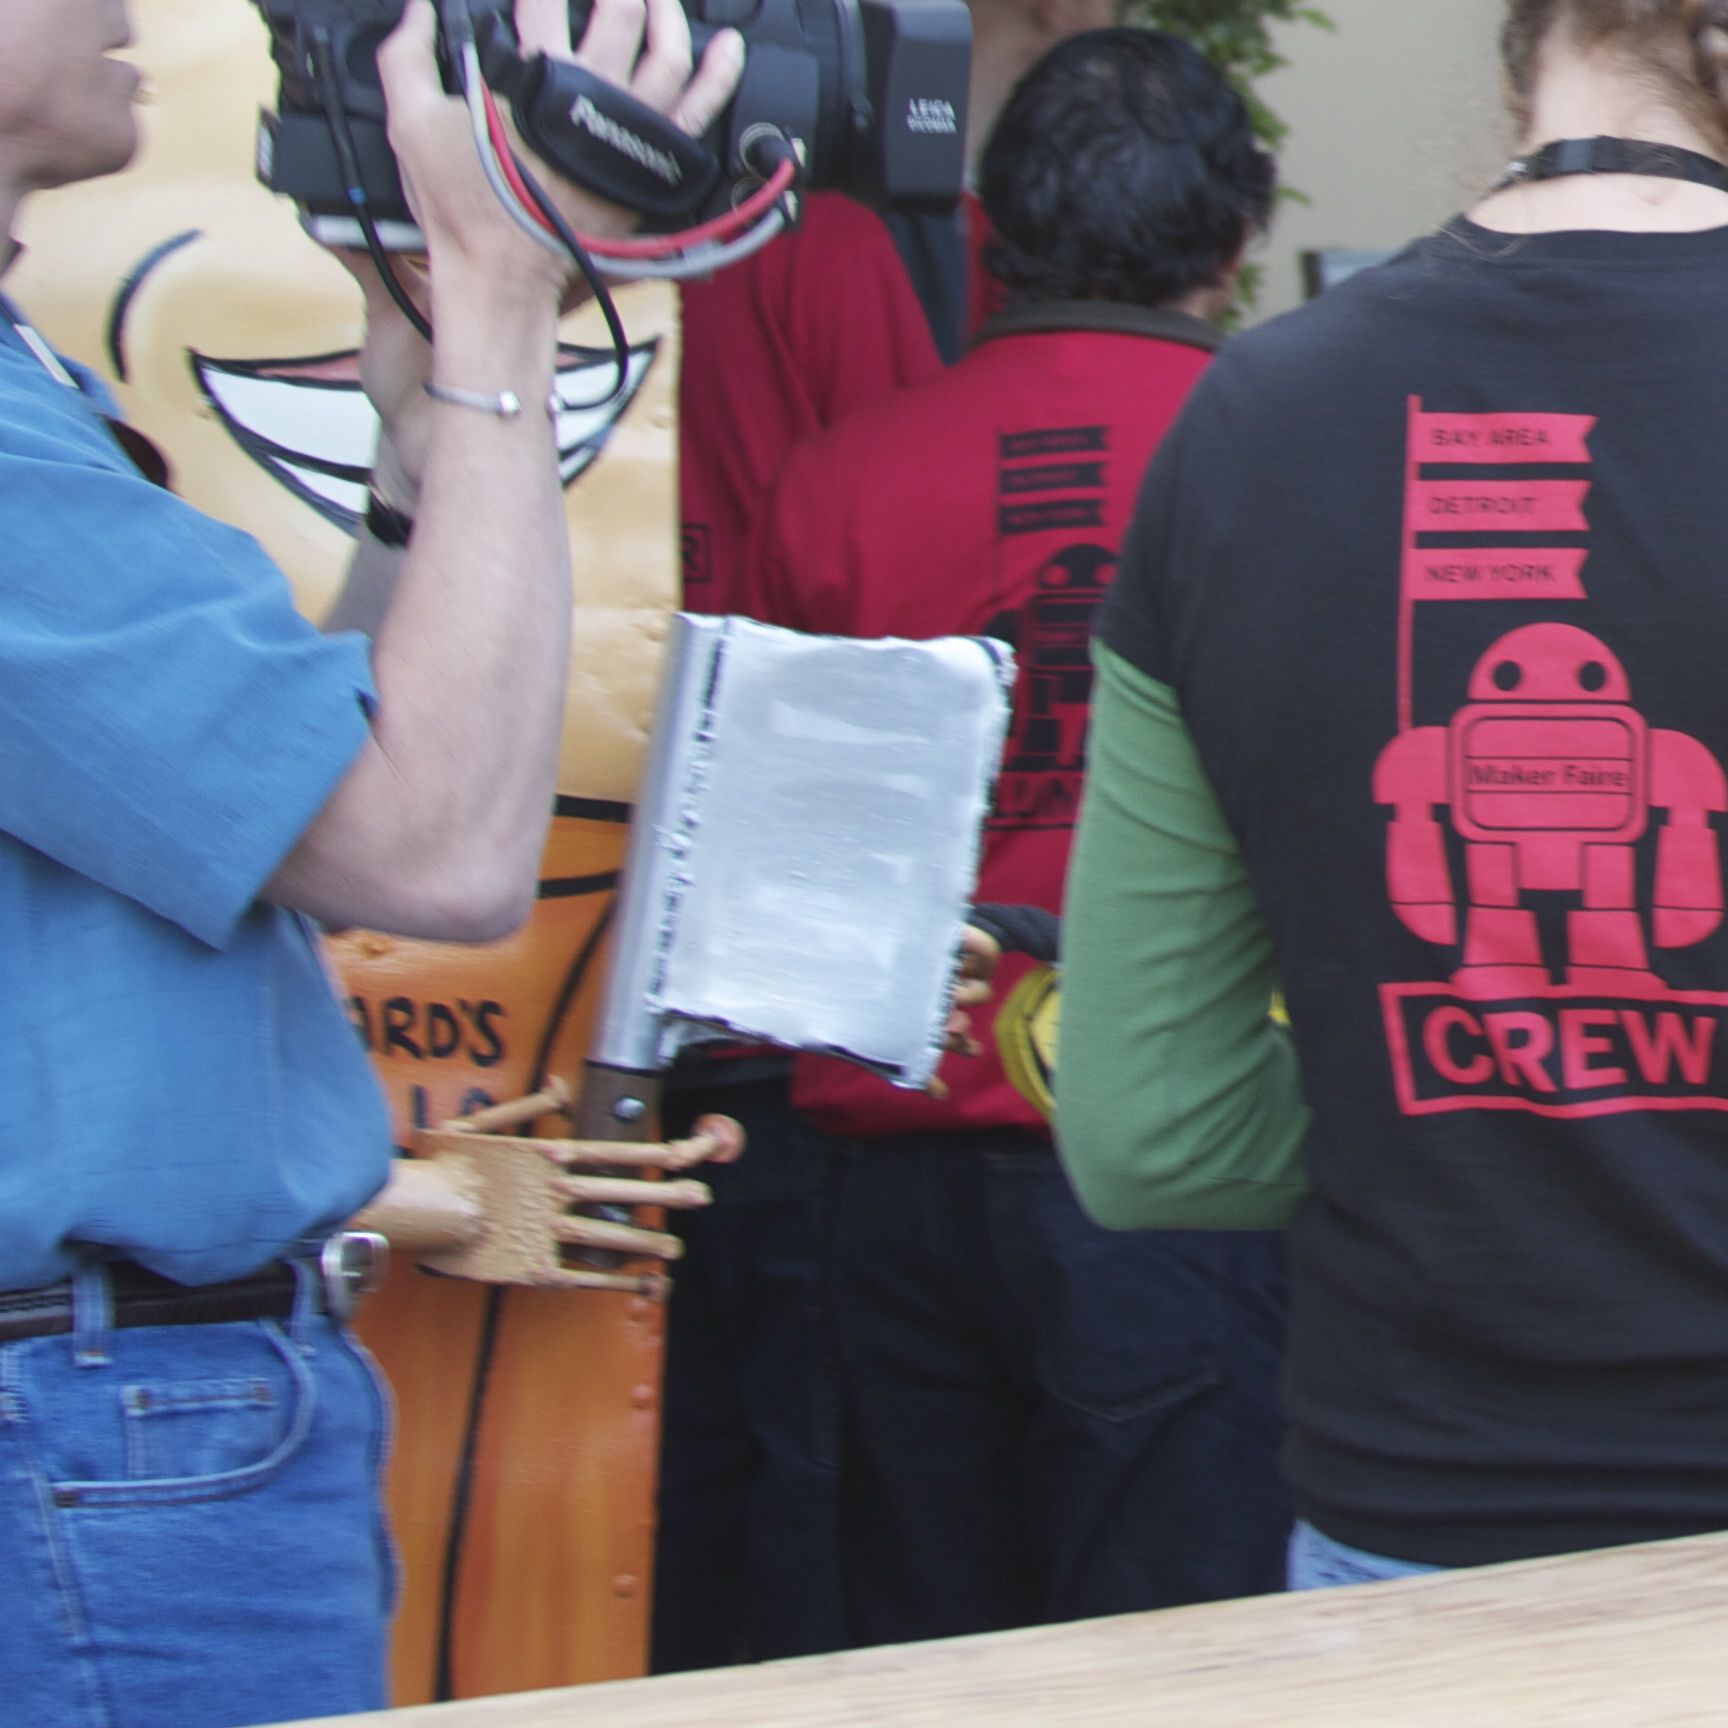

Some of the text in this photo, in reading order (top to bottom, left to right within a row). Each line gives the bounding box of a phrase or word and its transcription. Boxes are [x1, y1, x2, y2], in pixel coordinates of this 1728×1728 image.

[1431, 428, 1550, 447] BAY AREA
[1429, 496, 1537, 515] DETROIT
[1424, 563, 1555, 584] NEW YORK
[1470, 764, 1627, 787] Maker Faire
[1421, 1004, 1717, 1094] CREW
